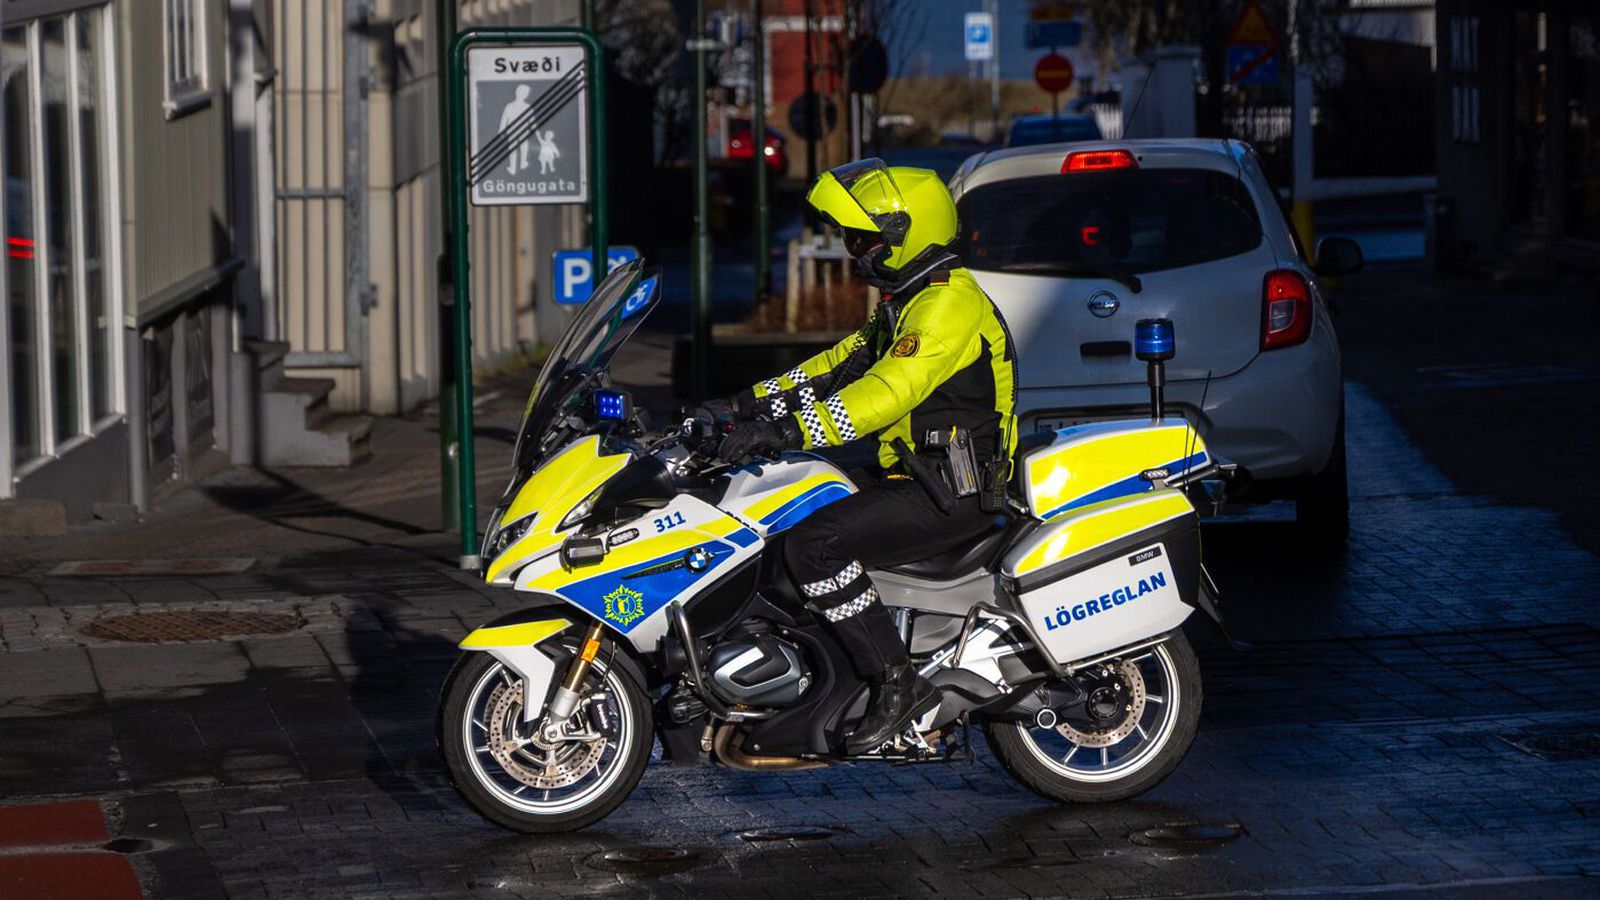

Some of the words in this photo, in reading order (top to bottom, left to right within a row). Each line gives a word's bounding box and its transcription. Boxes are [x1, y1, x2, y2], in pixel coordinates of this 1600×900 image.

[494, 56, 561, 73] Svæði
[483, 179, 576, 194] Göngugata
[563, 258, 591, 298] P
[653, 511, 686, 533] 311
[1136, 551, 1154, 562] BMW
[1044, 571, 1167, 631] LÖGREGLAN
